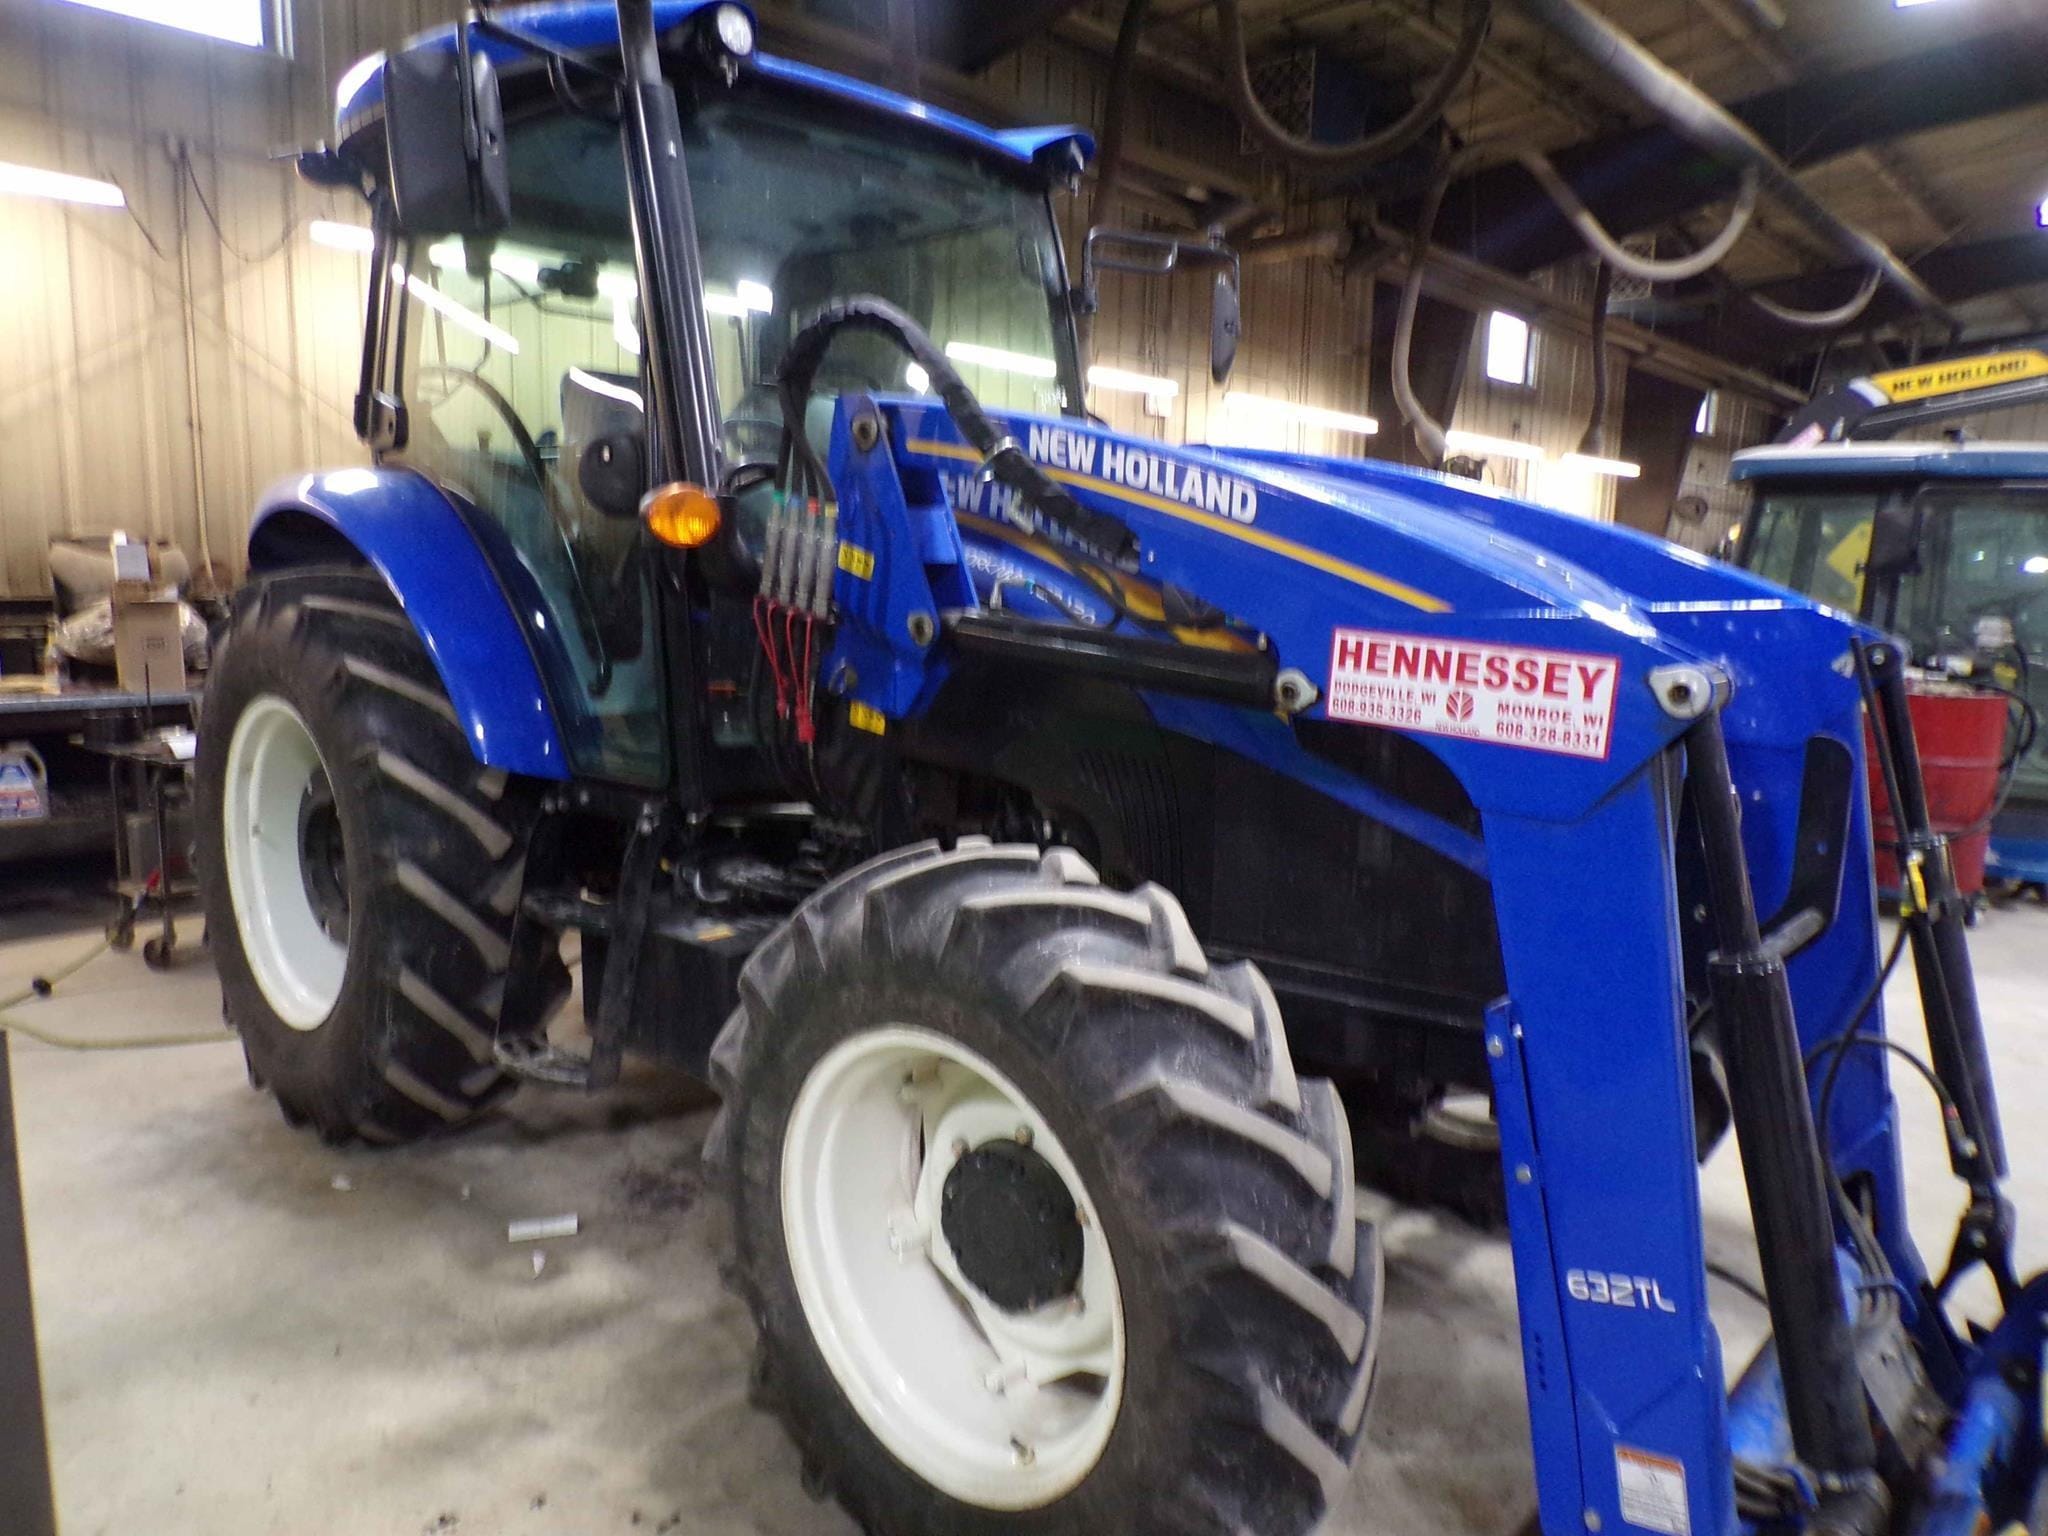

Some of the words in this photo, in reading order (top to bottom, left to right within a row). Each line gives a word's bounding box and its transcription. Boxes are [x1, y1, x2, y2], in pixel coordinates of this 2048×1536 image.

[941, 471, 985, 514] EW
[1029, 423, 1097, 474] NEW
[1103, 440, 1257, 525] HOLLAND
[1337, 638, 1607, 702] HENNESSEY
[1421, 690, 1436, 706] WI
[1583, 712, 1604, 727] WI
[1567, 1268, 1676, 1312] 632TL
